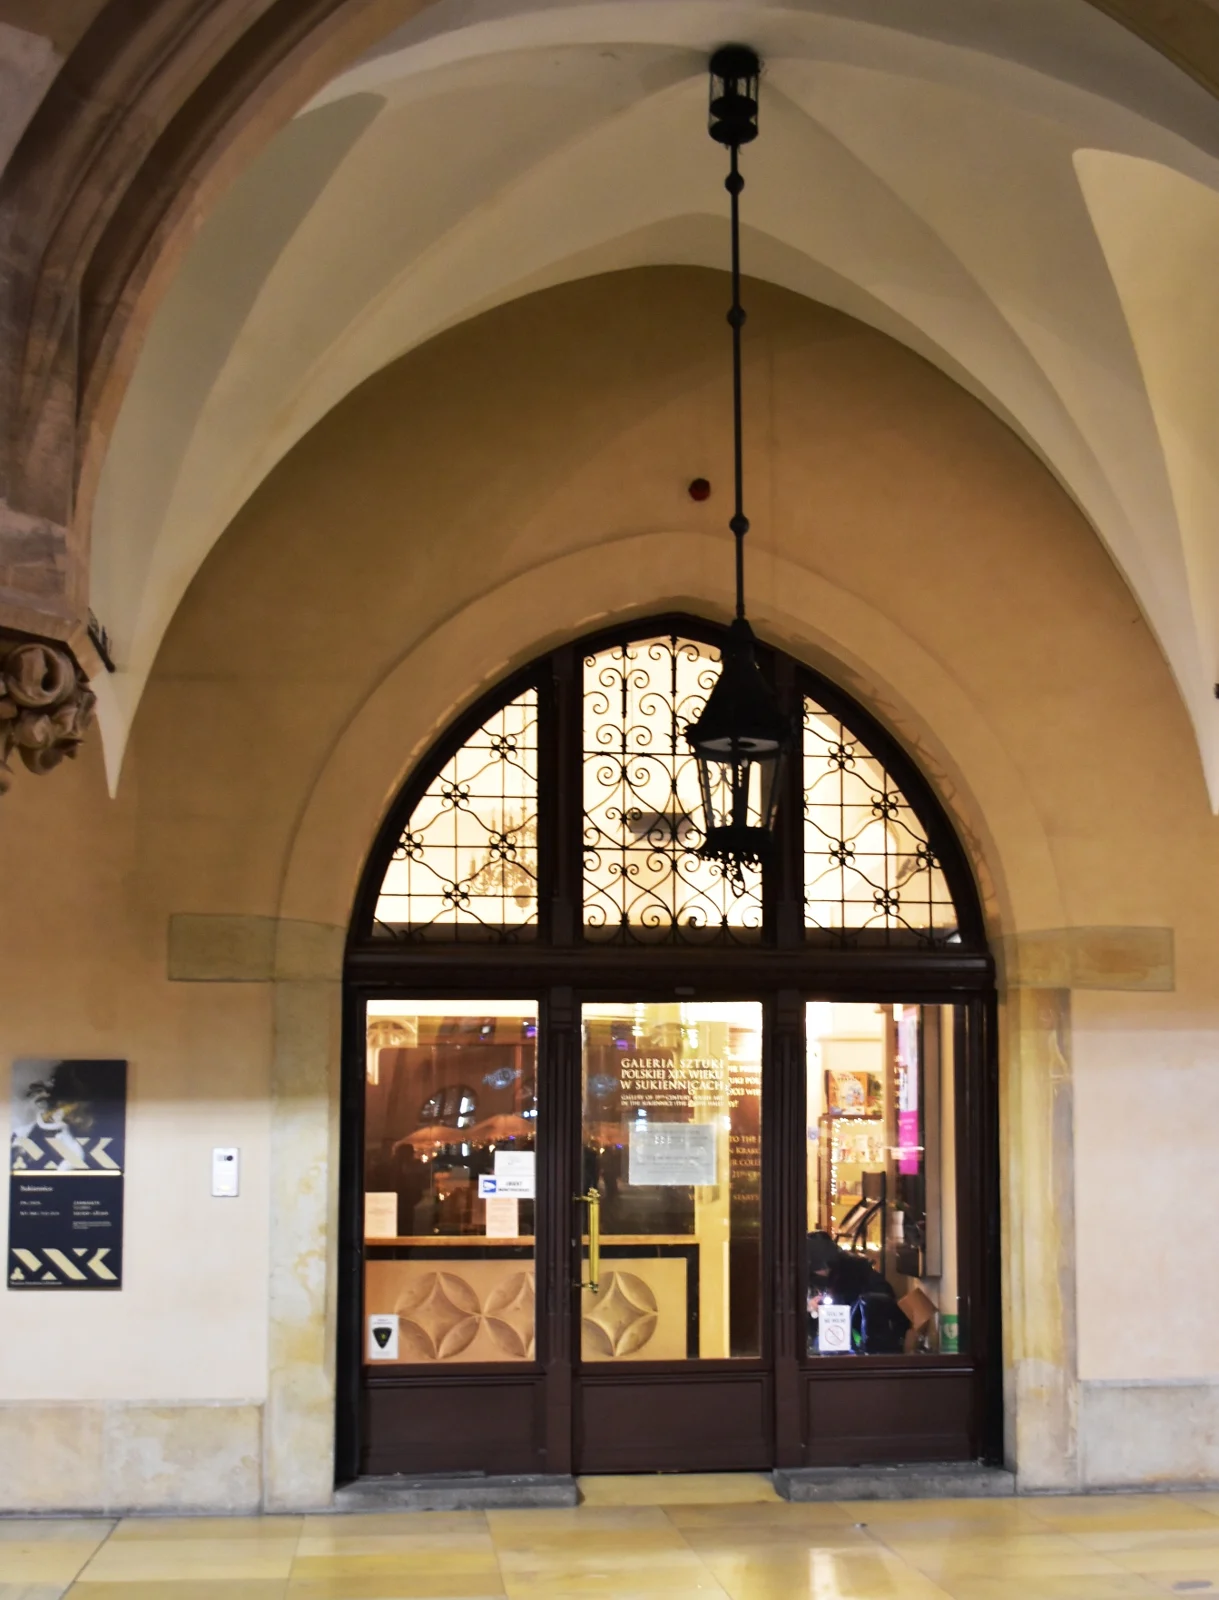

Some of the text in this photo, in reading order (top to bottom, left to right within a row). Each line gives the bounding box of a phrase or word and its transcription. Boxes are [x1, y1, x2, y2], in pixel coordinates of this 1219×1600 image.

[620, 1058, 724, 1069] GALERIA SZTUKI
[621, 1069, 666, 1081] POLSKIEJ
[668, 1069, 687, 1080] XIX
[689, 1069, 724, 1080] WIEKU
[620, 1080, 724, 1091] W SUKIENNICACH
